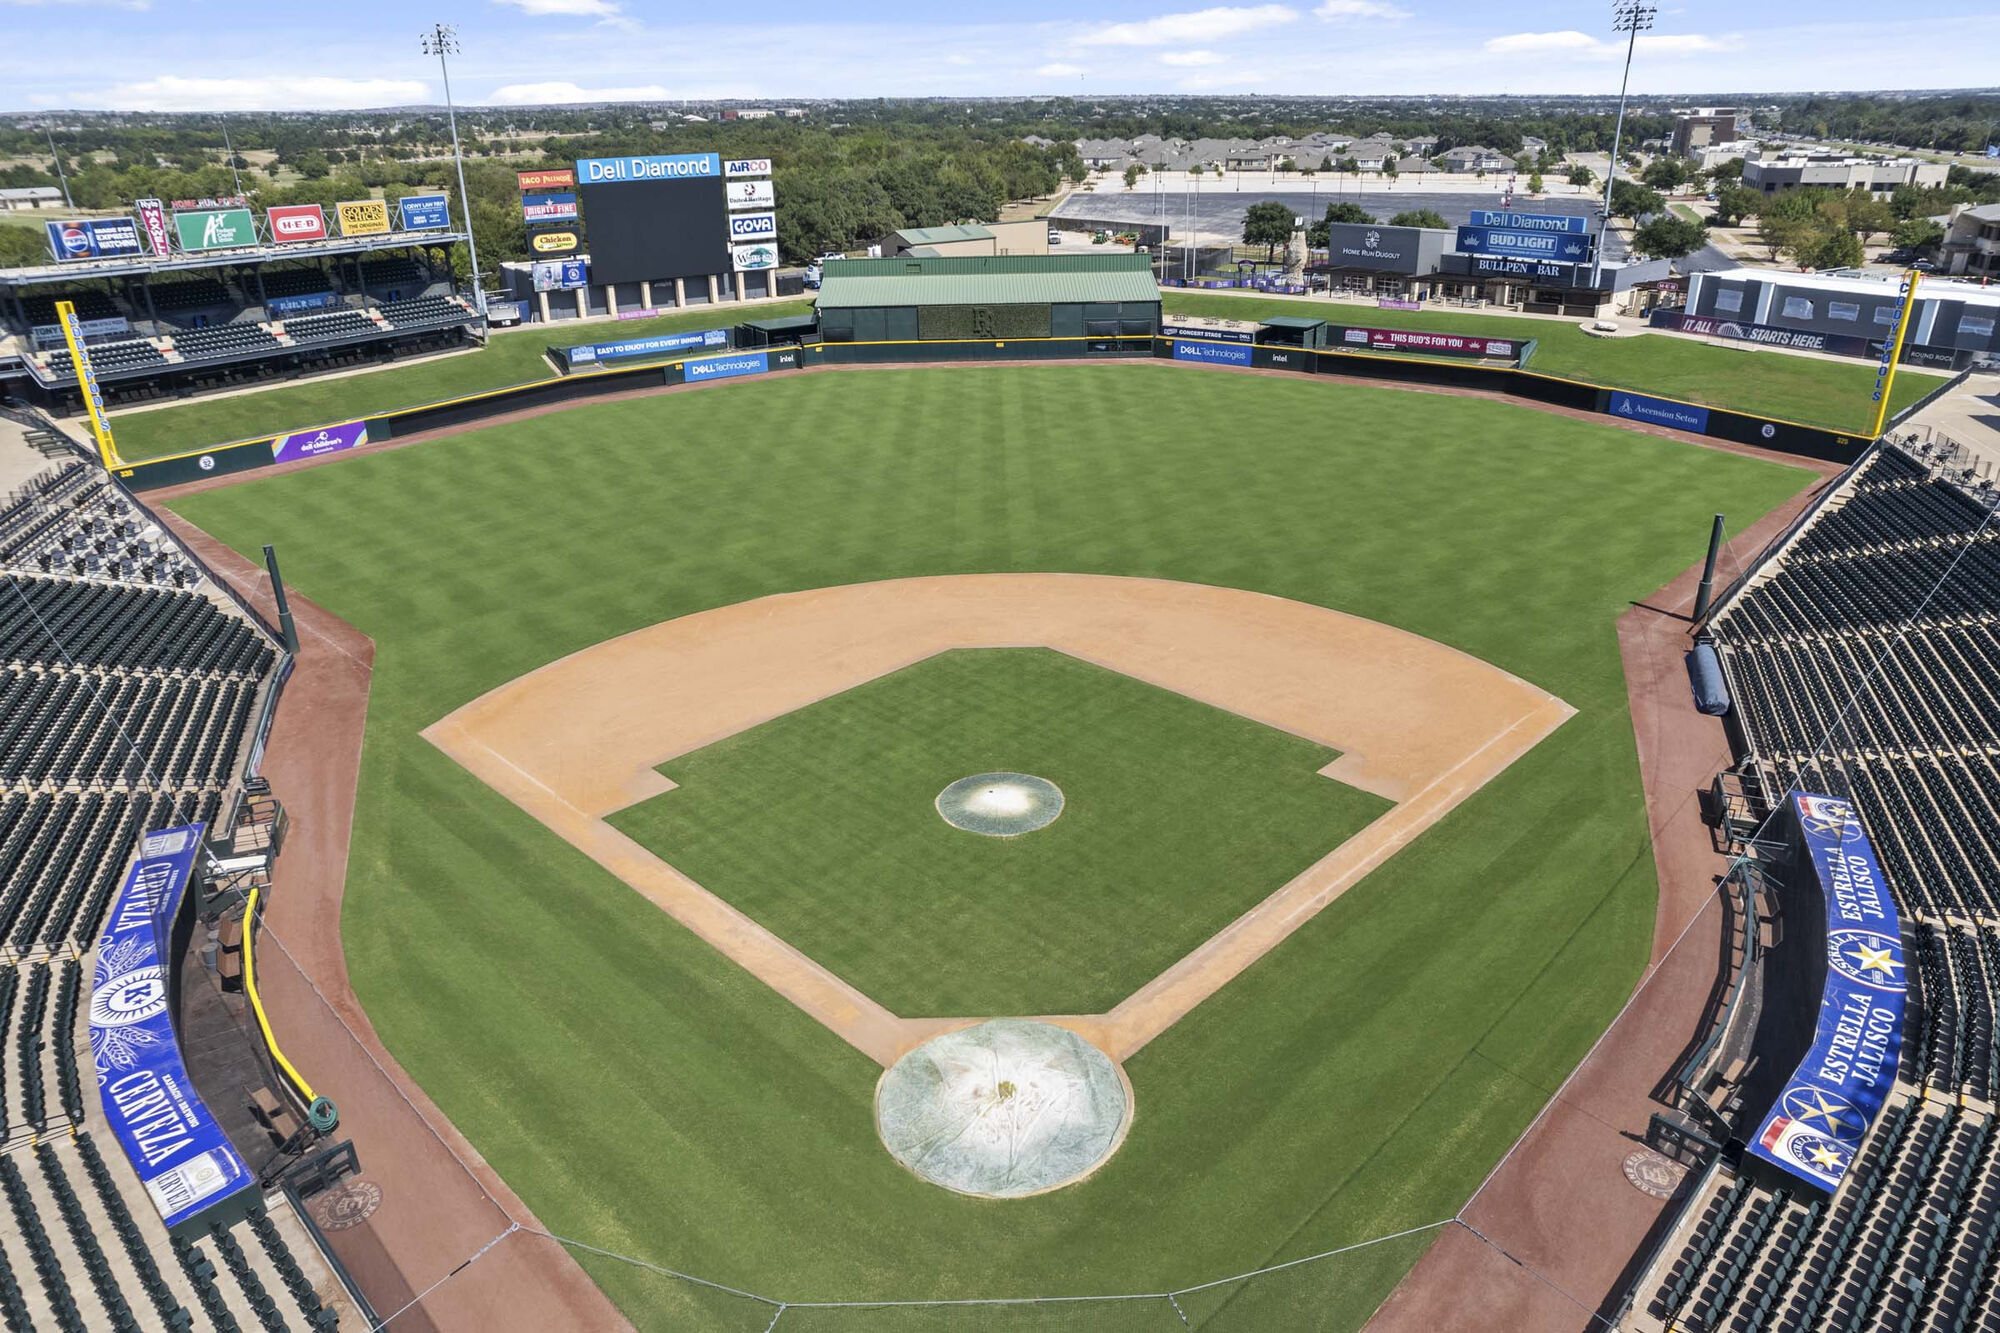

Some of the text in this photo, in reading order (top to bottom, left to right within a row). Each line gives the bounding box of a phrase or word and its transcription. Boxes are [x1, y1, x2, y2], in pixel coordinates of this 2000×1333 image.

[588, 156, 710, 181] Dell Diamond
[342, 204, 383, 217] GOLDEN
[527, 204, 574, 215] MIGHTY FINE
[348, 213, 381, 223] CHICK
[733, 218, 772, 234] GOYA
[1483, 213, 1569, 231] Dell Diamond
[145, 210, 169, 256] MAXWELL
[540, 235, 572, 244] Chicken
[1489, 234, 1555, 250] BUD LIGHT
[1361, 249, 1375, 257] RUN
[1479, 260, 1560, 276] BULLPEN BAR
[1682, 319, 1712, 333] IT ALL
[1390, 333, 1464, 348] THIS BUD'S FOR YOU
[1749, 328, 1792, 345] STARTS
[597, 347, 614, 355] EASY
[624, 343, 645, 351] ENJOY
[659, 338, 680, 347] EVERY
[1180, 345, 1202, 355] DELL
[779, 354, 795, 364] intel
[1272, 353, 1288, 363] intel
[1911, 351, 1935, 360] ROUND
[692, 364, 715, 375] DELL
[714, 359, 760, 373] Technologies
[1634, 404, 1698, 425] Ascension Seton
[301, 443, 314, 451] dell
[1824, 847, 1863, 922] ESTRELLA
[1847, 855, 1885, 919] JALISCO
[114, 862, 173, 933] CERVEZA
[124, 983, 152, 1004] K
[1819, 993, 1873, 1086] ESTRELLA
[1851, 1008, 1896, 1088] JALISCO
[109, 1070, 195, 1167] CERVEZA
